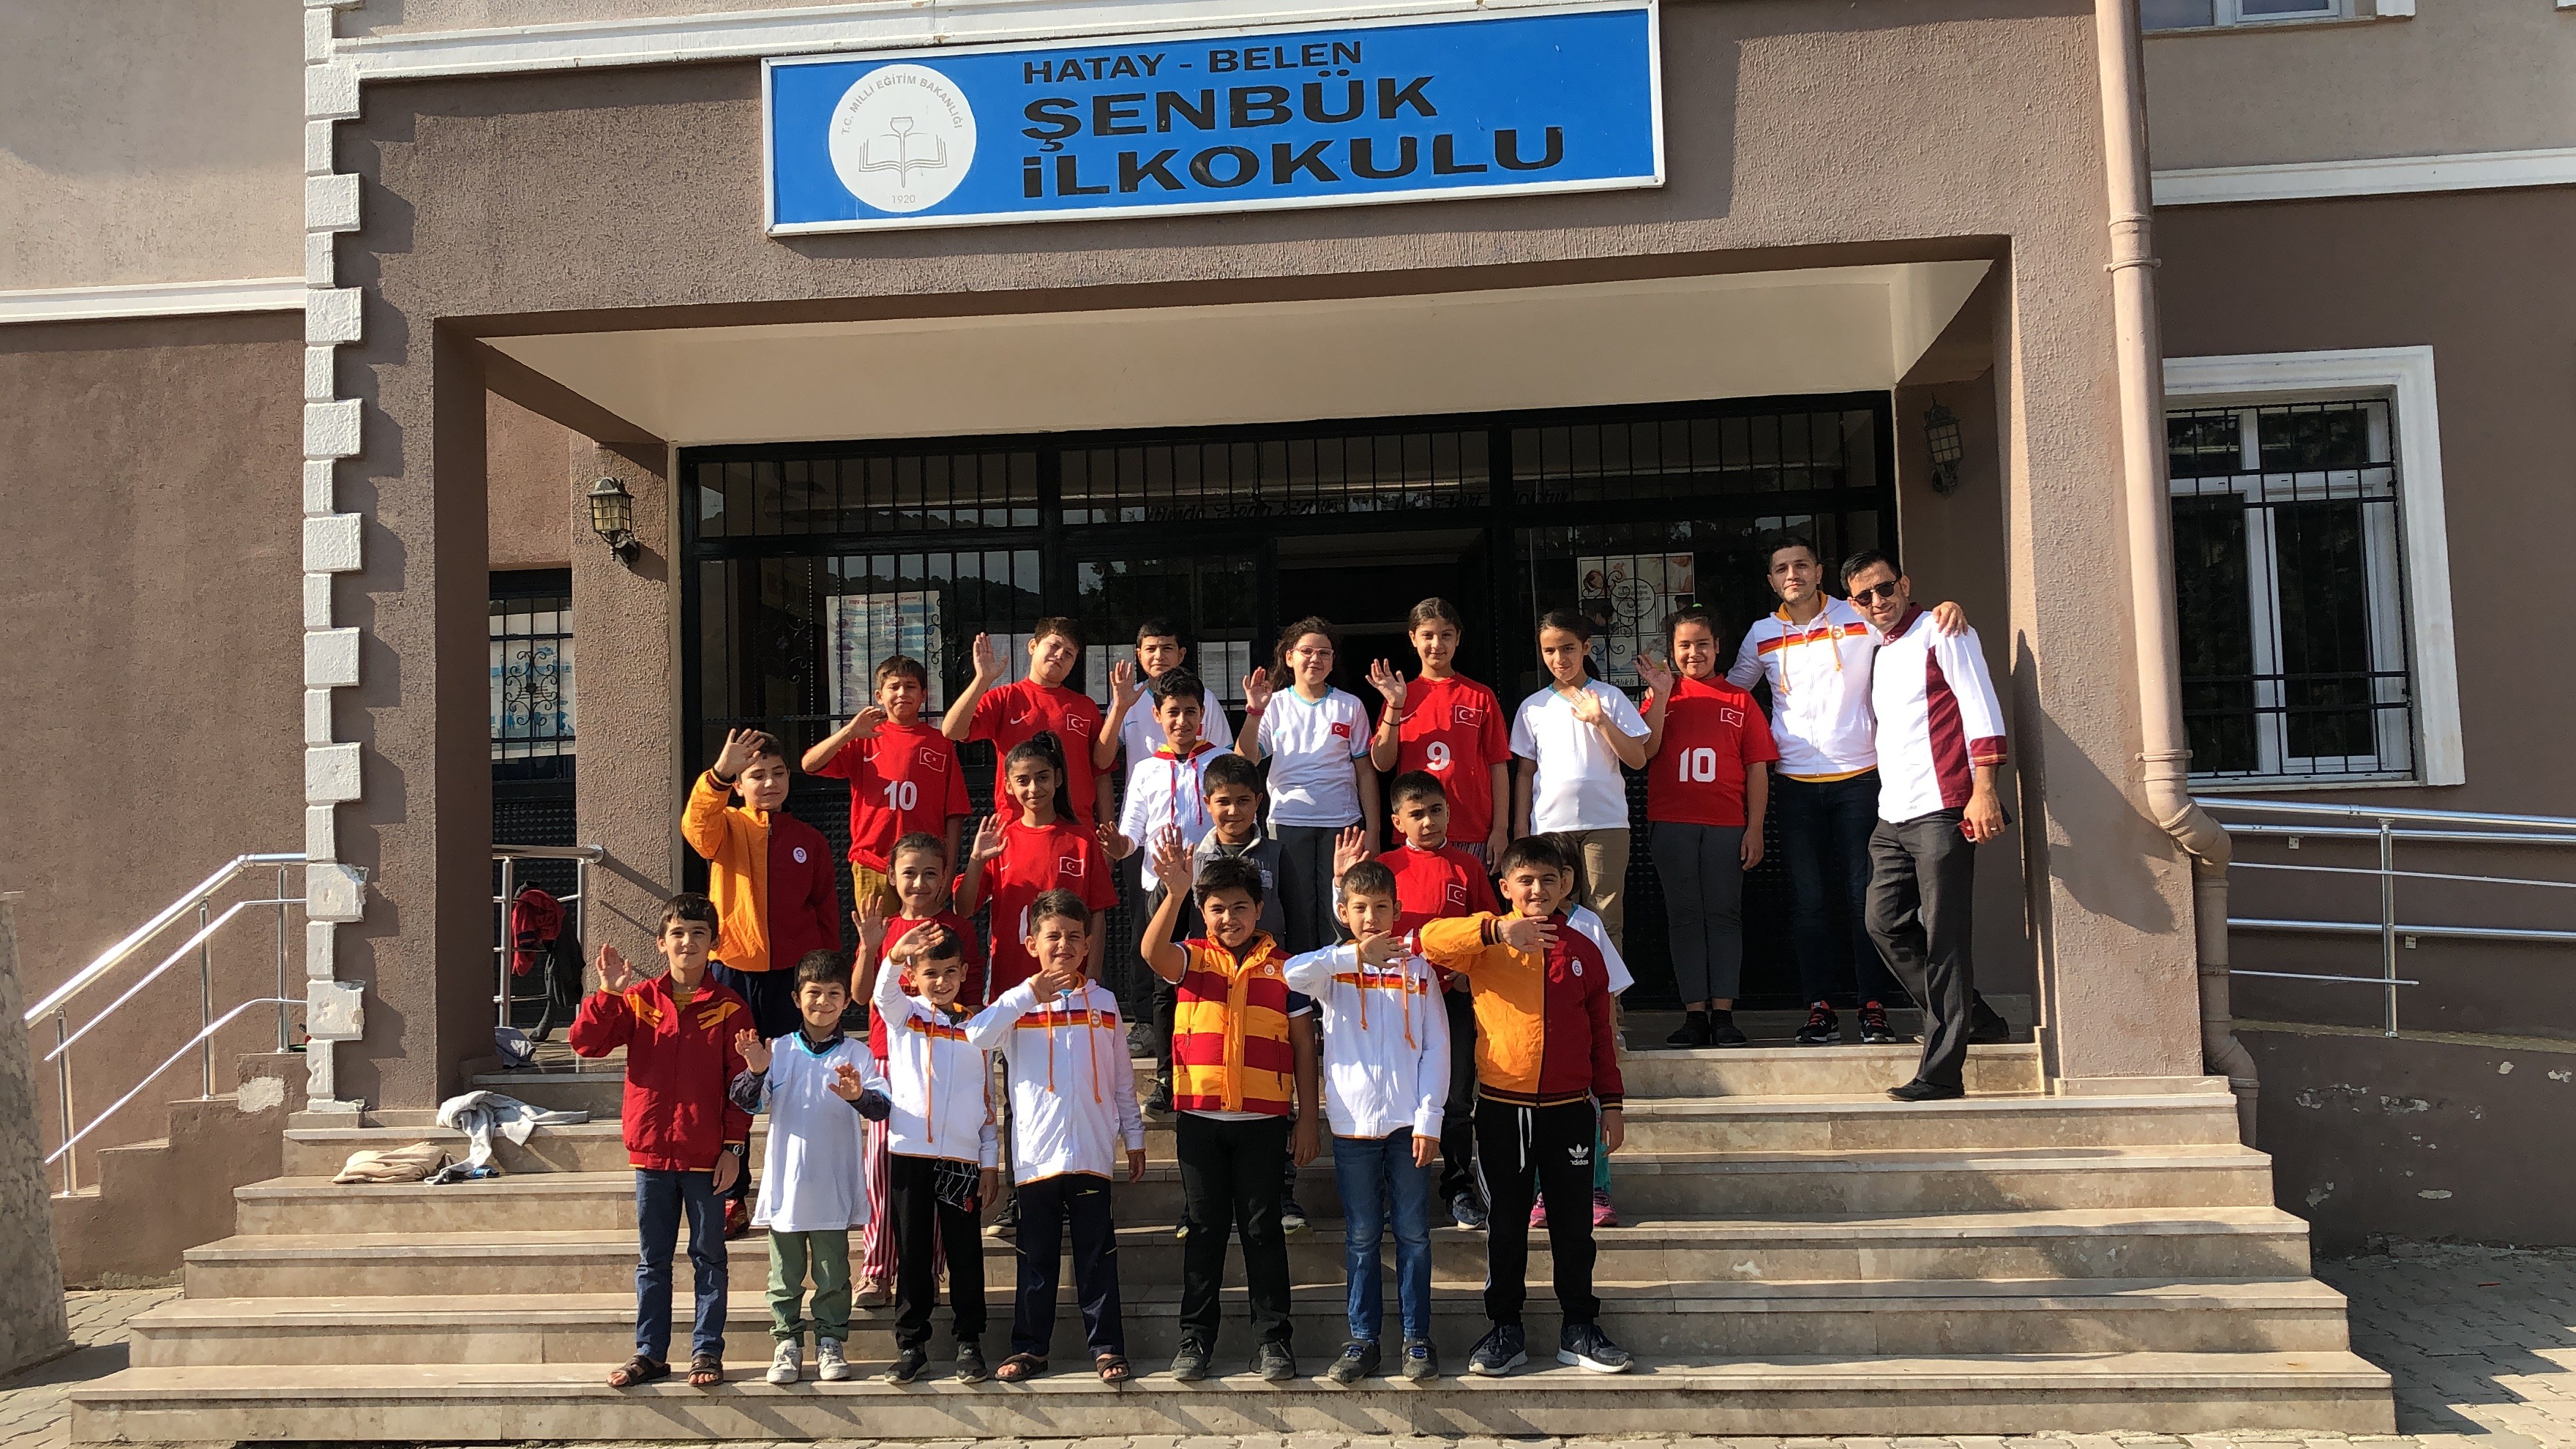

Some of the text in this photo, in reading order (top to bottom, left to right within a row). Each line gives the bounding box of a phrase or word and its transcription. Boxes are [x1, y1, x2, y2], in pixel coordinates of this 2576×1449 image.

[1024, 52, 1166, 84] HATAY
[1209, 40, 1361, 73] BELEN
[841, 72, 963, 135] T.C. MİLLİ EĞİTİM BAKANLIĞI
[1021, 68, 1438, 152] ŞENBÜK
[891, 194, 916, 204] 1920
[1426, 741, 1450, 771] 9
[1679, 746, 1716, 782] 10
[883, 780, 918, 811] 10
